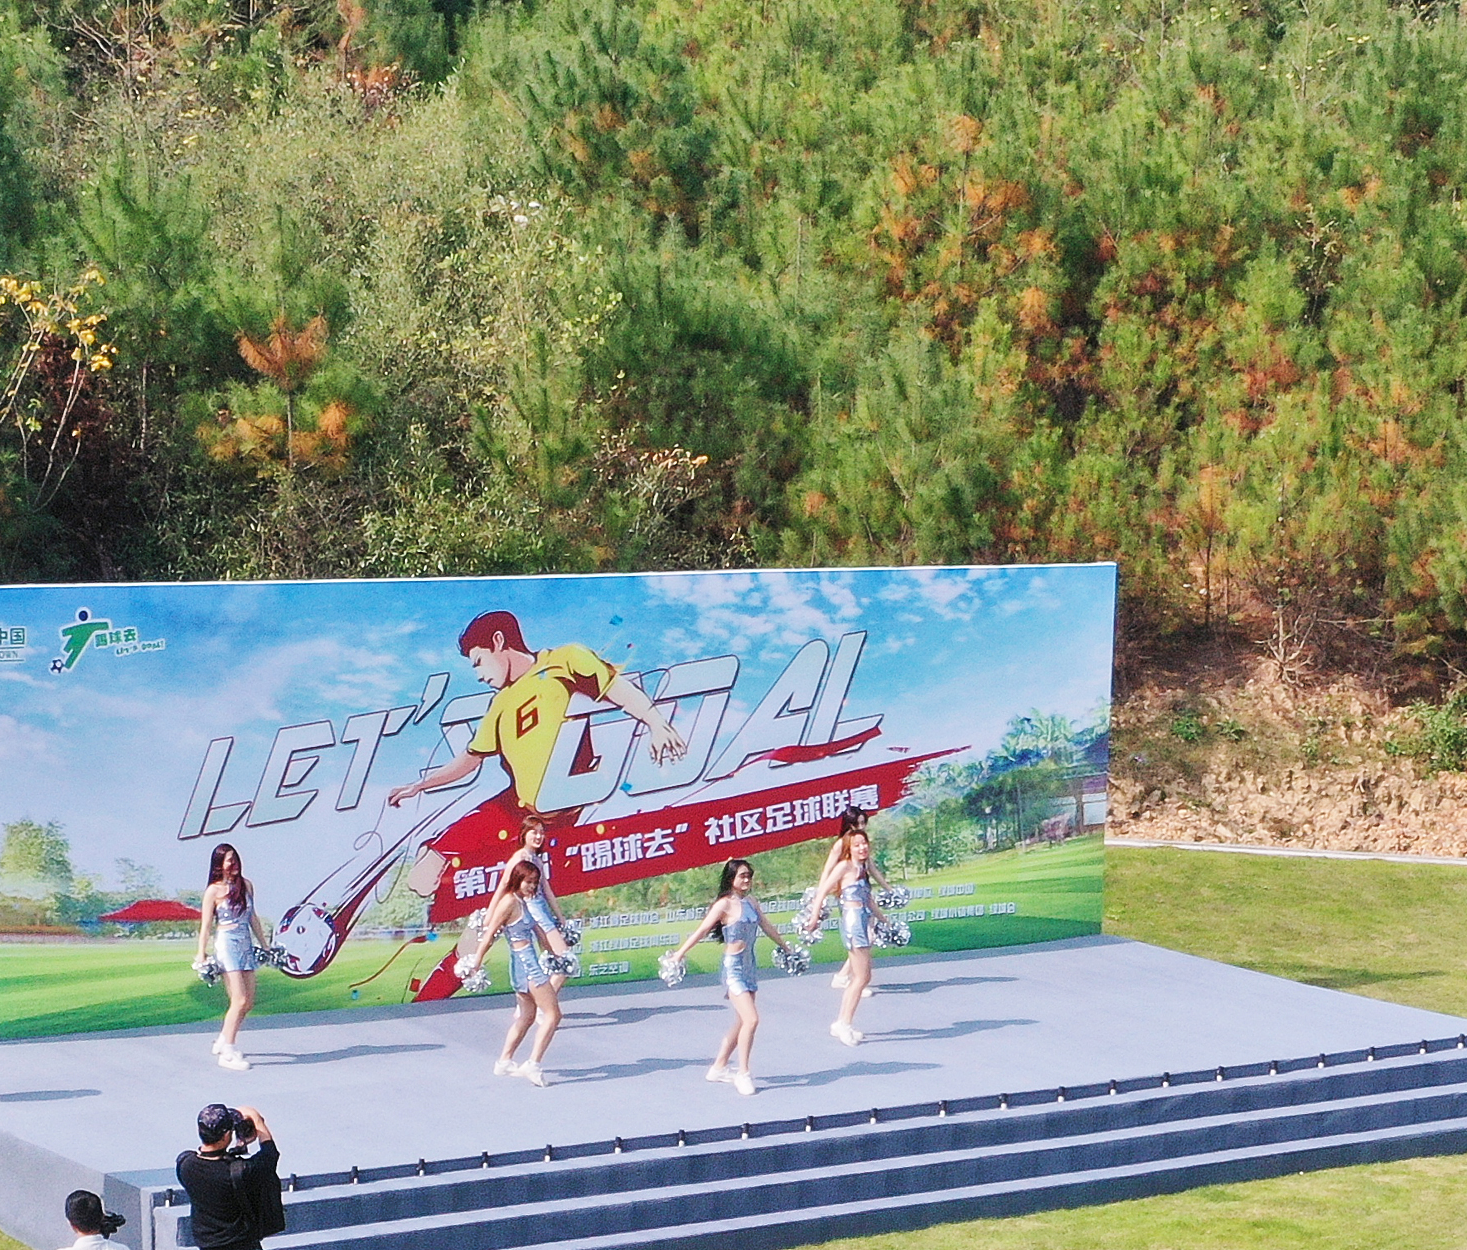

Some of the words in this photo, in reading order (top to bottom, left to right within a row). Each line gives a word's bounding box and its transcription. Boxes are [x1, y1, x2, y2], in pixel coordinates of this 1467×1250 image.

[516, 695, 538, 738] 6
[177, 672, 496, 840] LET'S
[705, 783, 879, 847] 社区足球联赛
